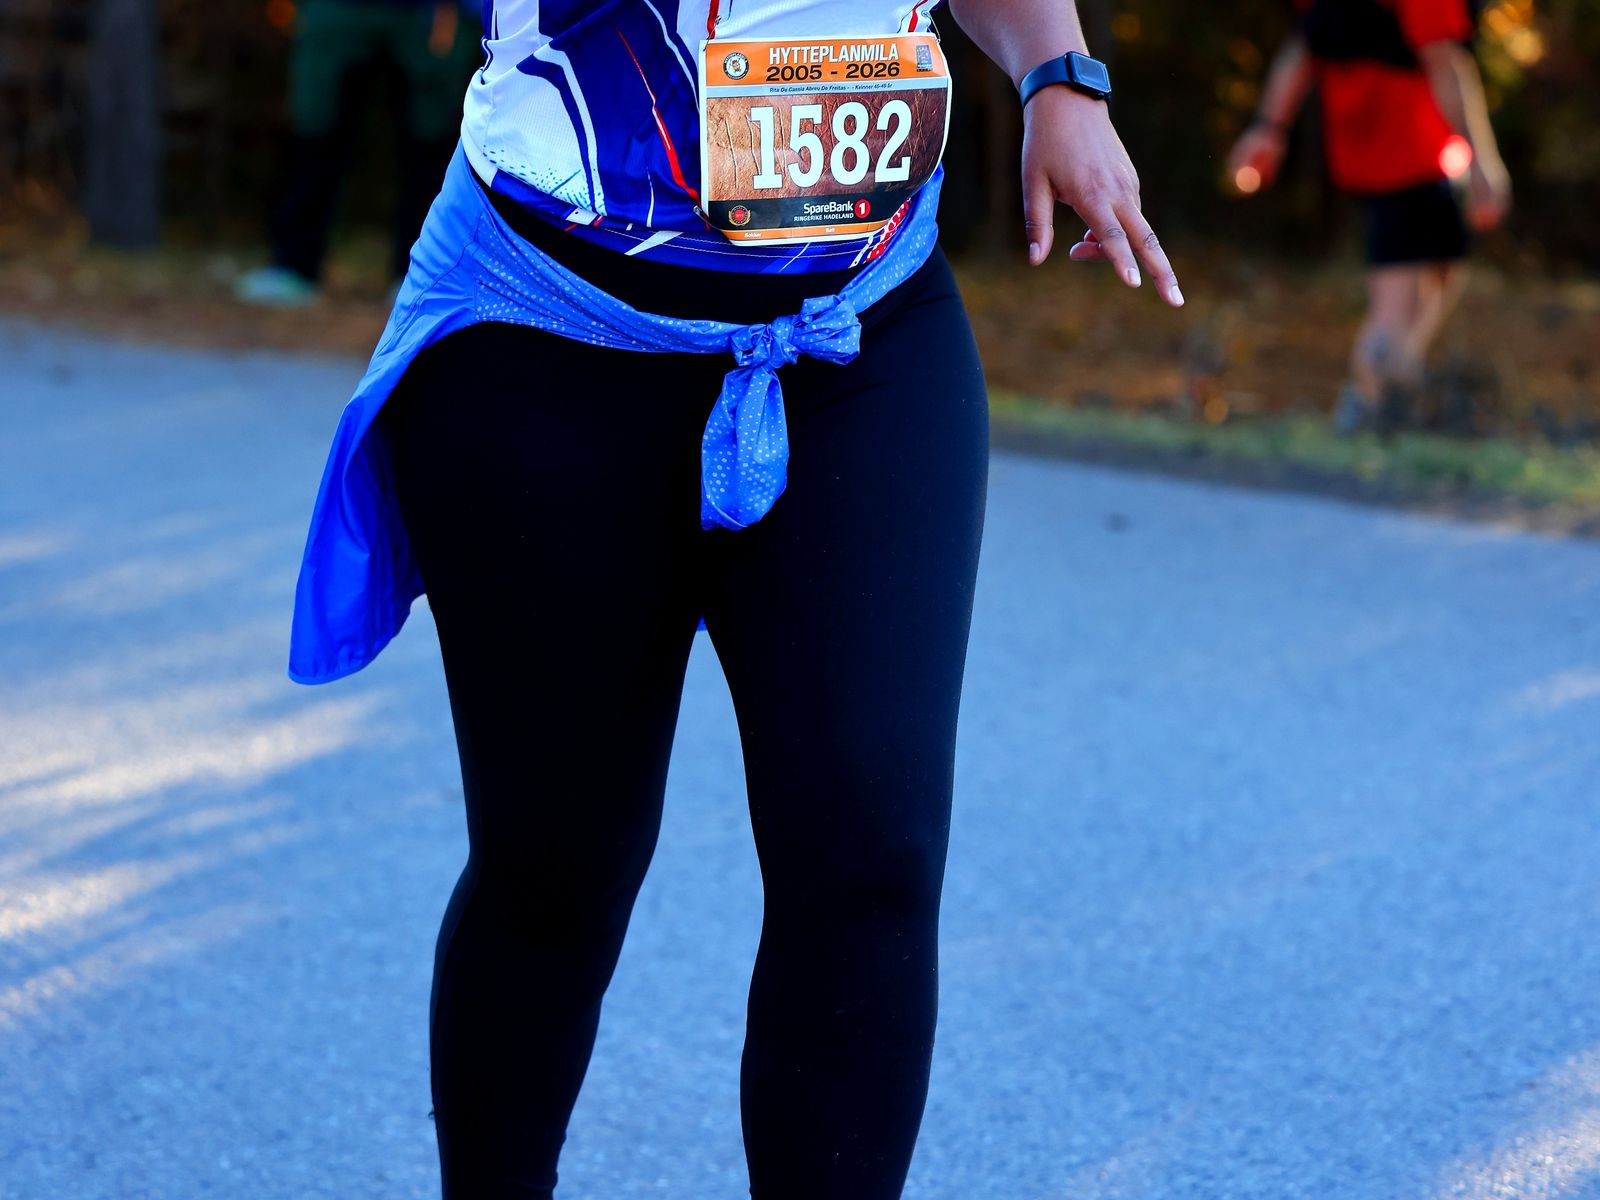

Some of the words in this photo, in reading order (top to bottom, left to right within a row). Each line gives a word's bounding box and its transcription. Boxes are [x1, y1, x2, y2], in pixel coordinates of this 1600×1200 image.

[769, 43, 899, 64] HYTTEPLANMILA
[766, 65, 822, 81] 2005
[846, 62, 900, 78] 2026
[750, 99, 913, 190] 1582
[803, 200, 854, 215] SpareBank
